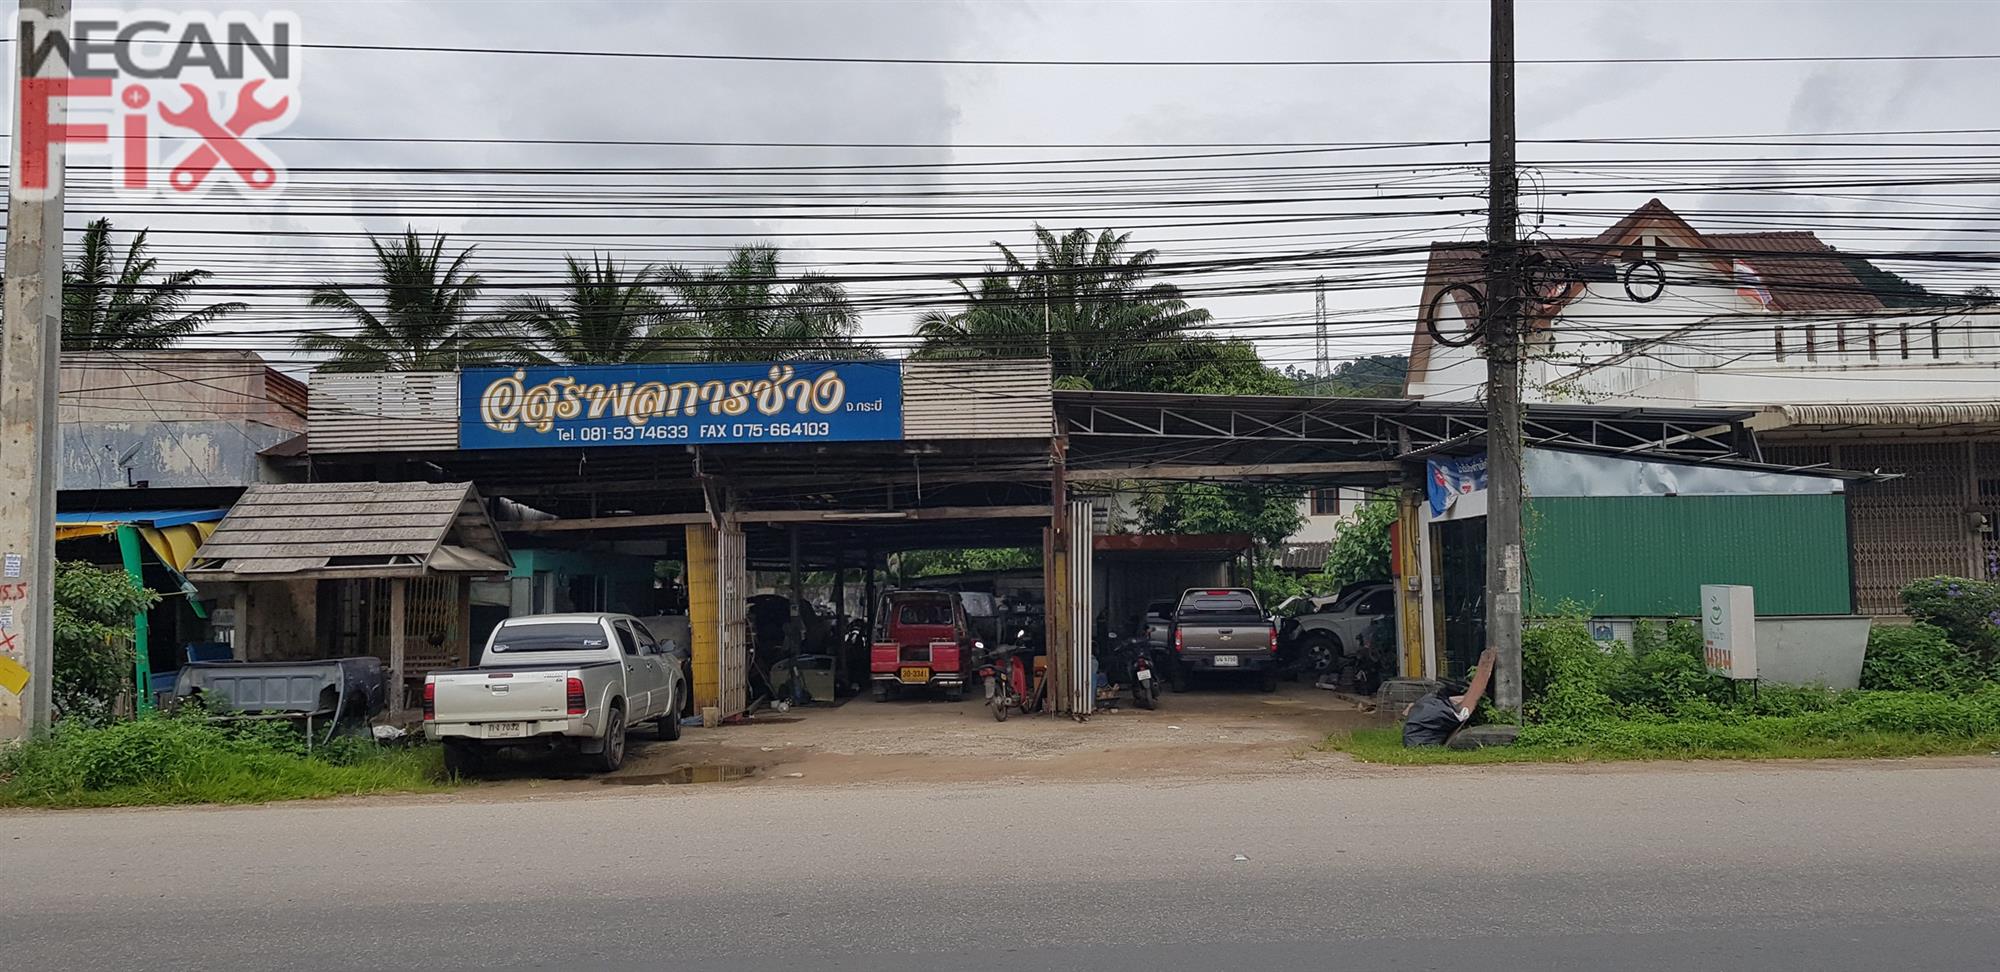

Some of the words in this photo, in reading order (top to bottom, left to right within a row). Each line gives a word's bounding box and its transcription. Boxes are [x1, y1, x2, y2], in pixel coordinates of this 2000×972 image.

[557, 428, 576, 441] Tel.
[580, 425, 689, 441] 081-5374633
[700, 424, 727, 438] FAX
[732, 422, 829, 437] 075-664103
